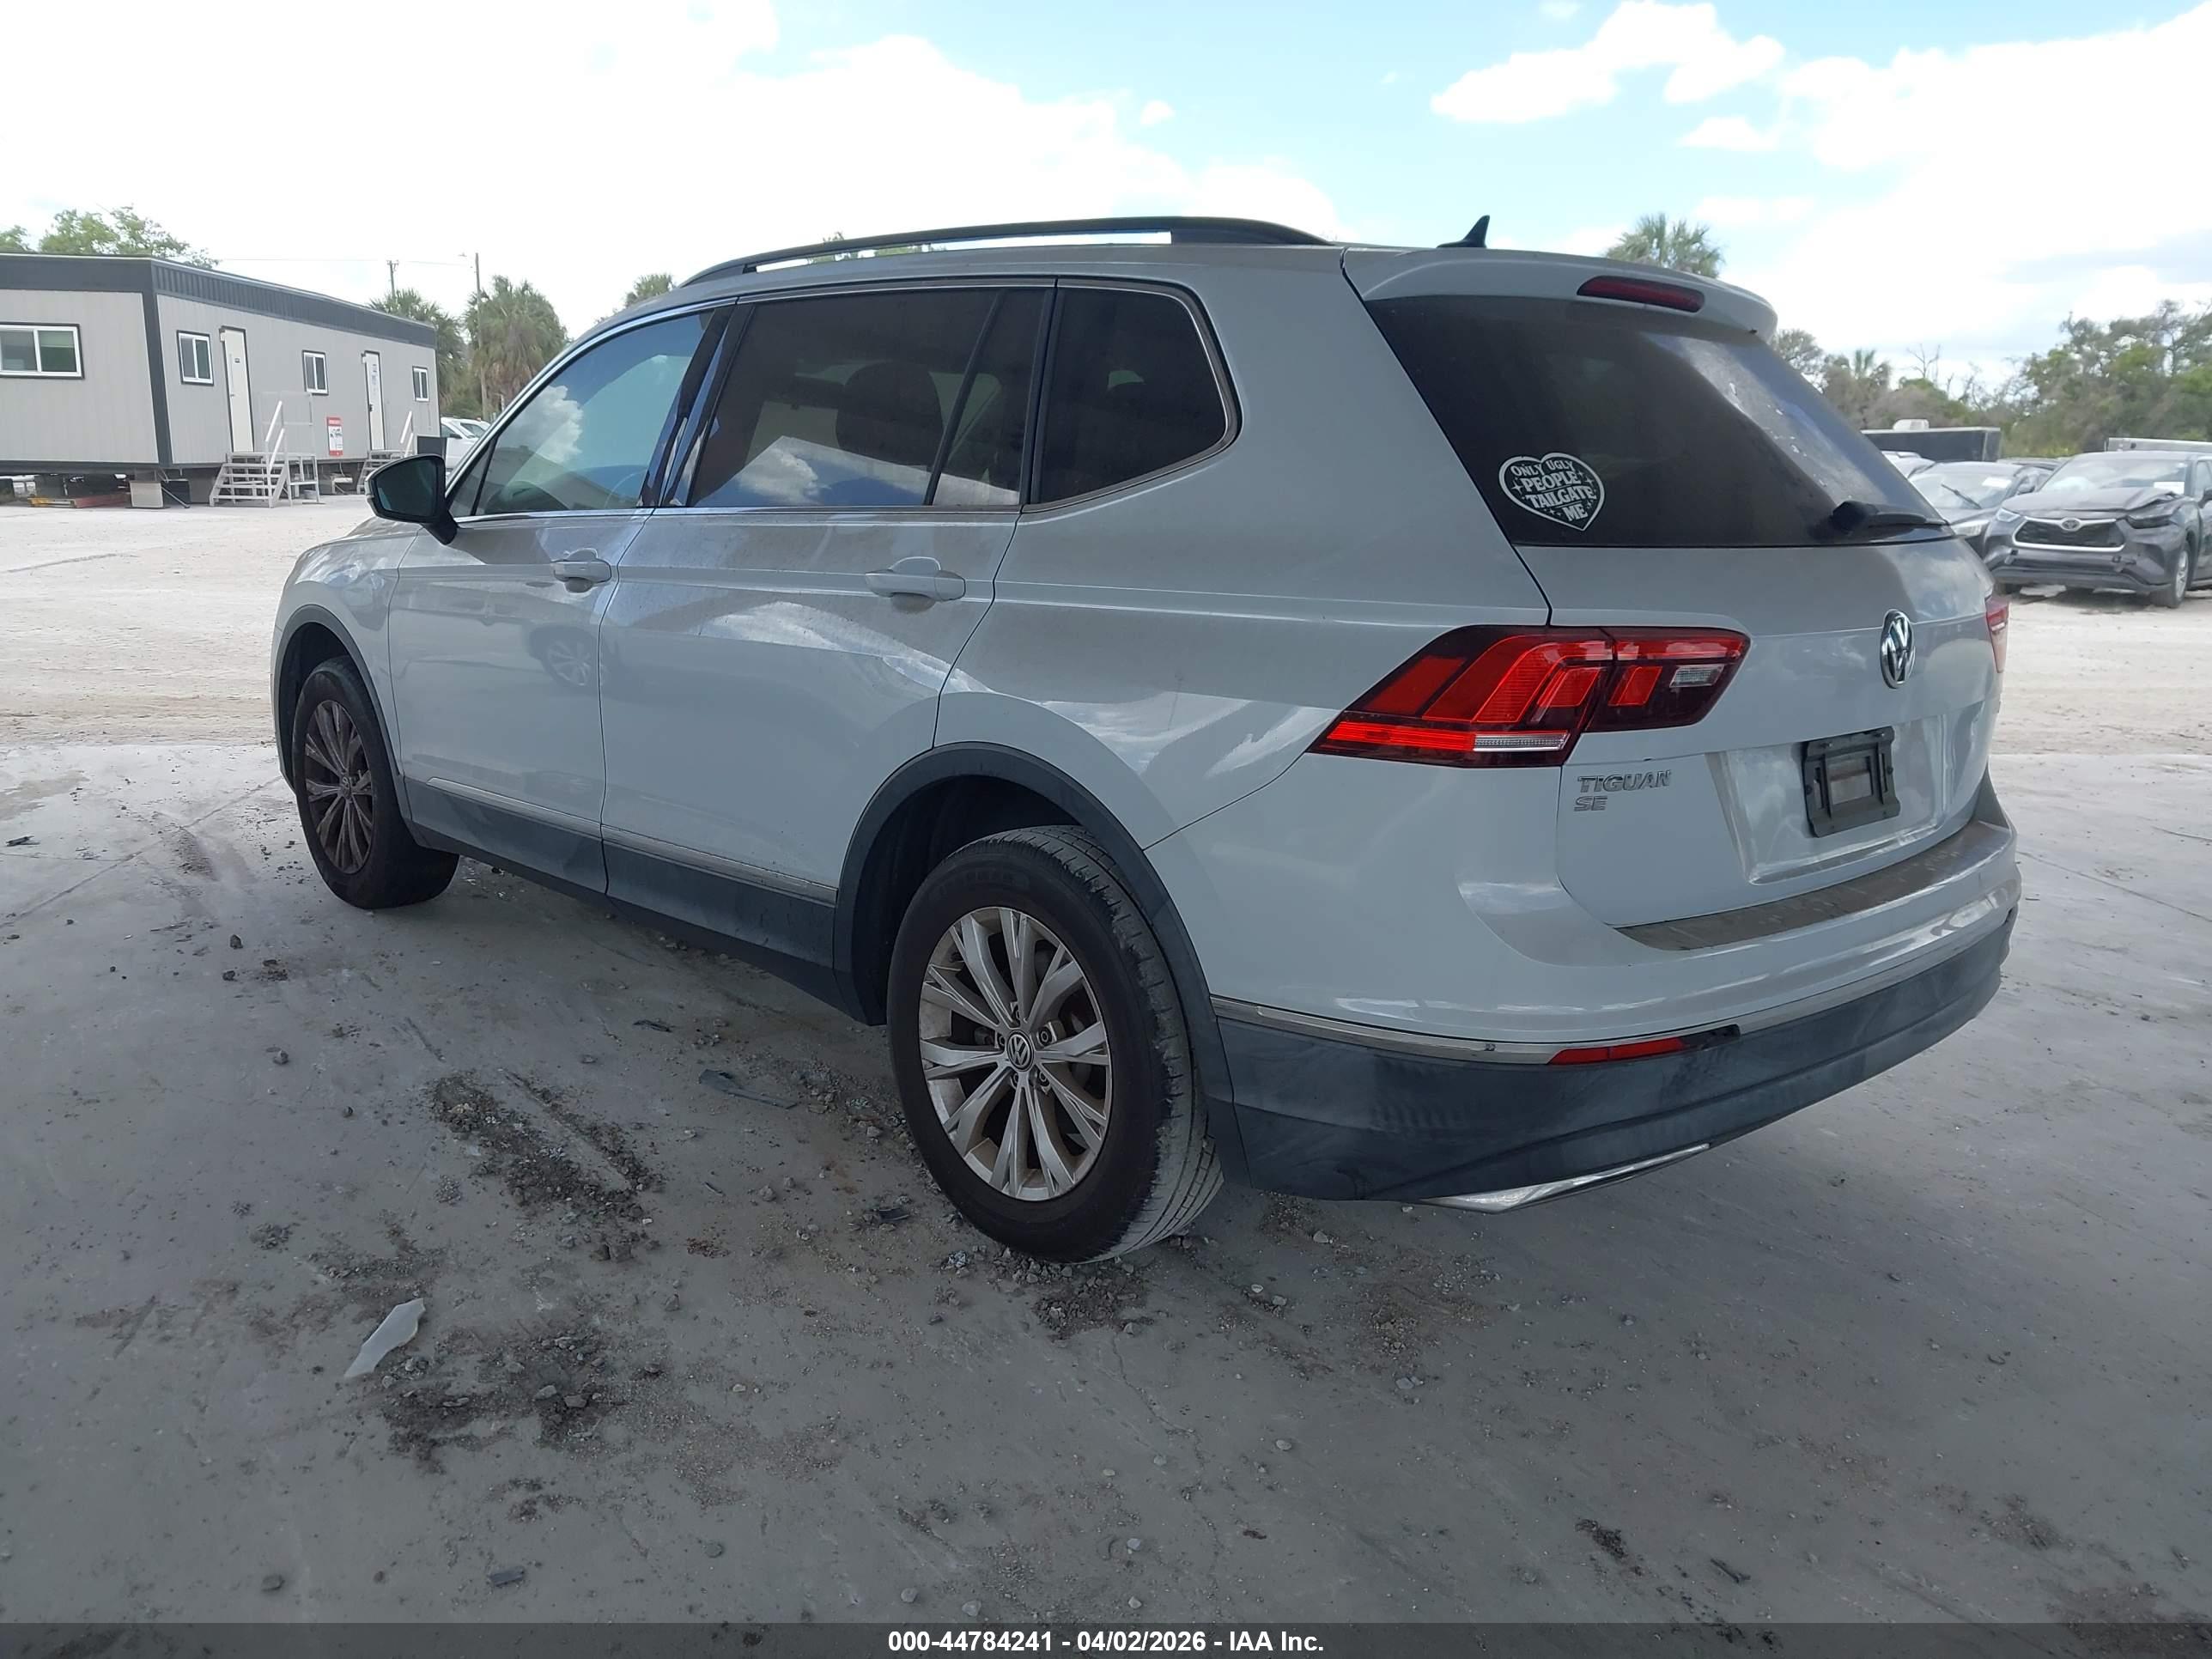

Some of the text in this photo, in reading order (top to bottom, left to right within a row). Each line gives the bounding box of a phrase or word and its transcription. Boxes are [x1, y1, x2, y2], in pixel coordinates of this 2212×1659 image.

[1510, 459, 1575, 477] ONLY UGLY
[1520, 471, 1582, 492] PEOPLE
[1525, 486, 1596, 508] TAILGATE
[1561, 503, 1589, 521] ME
[1577, 770, 1672, 793] TIGUAN
[1573, 795, 1607, 811] SE
